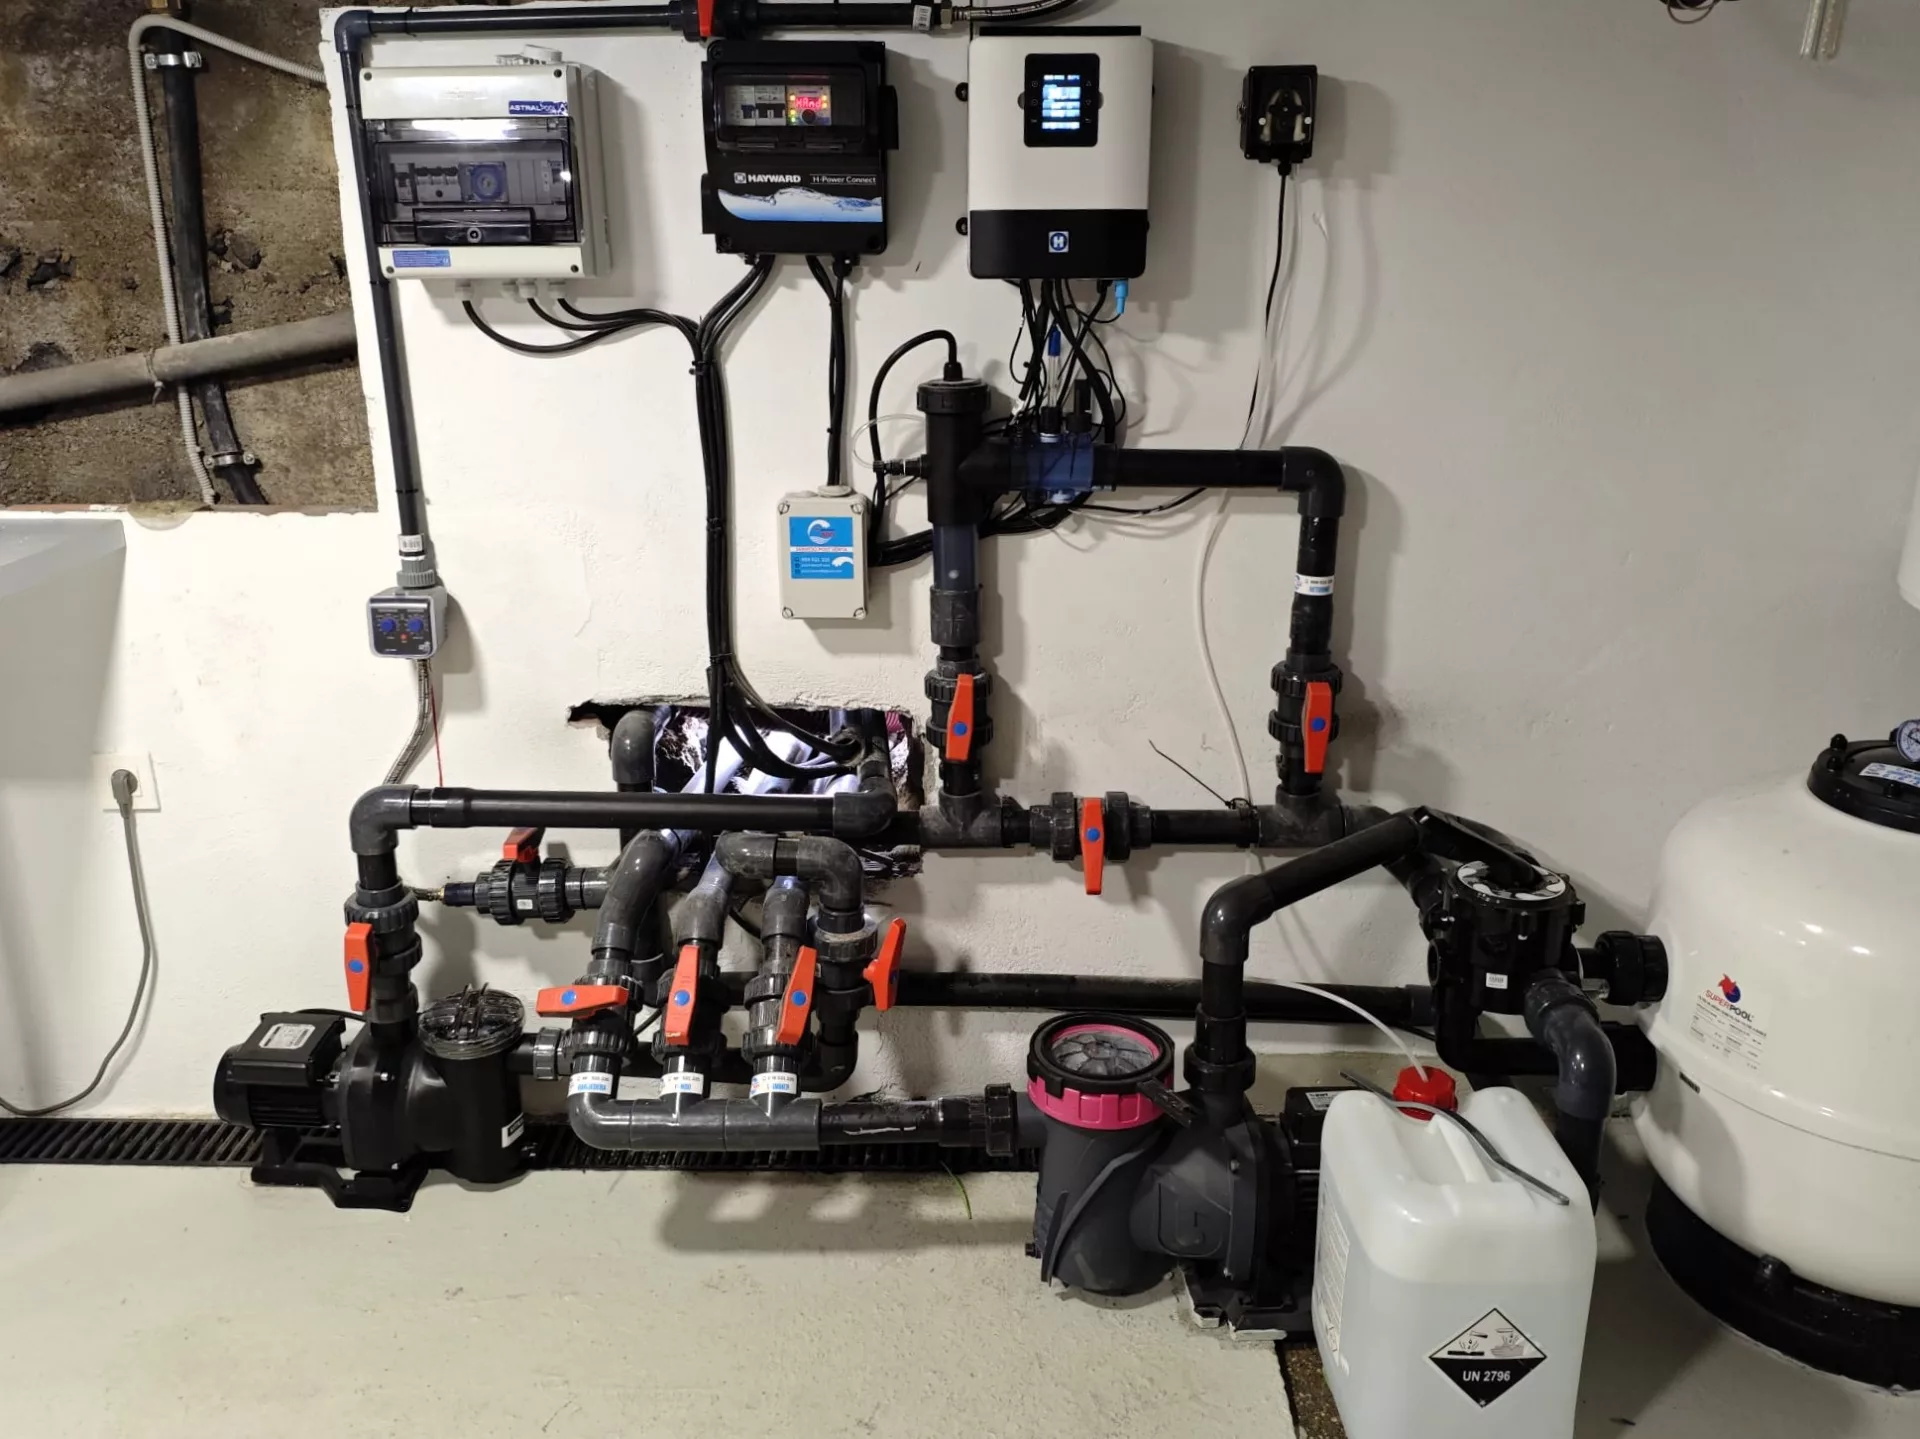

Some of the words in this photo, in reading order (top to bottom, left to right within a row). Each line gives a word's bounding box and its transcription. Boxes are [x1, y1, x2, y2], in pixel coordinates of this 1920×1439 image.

[748, 174, 802, 183] HAYWARD
[846, 175, 877, 183] Connect
[1705, 989, 1753, 1023] SUPERPOOL
[1462, 1370, 1481, 1382] UN
[1483, 1370, 1511, 1382] 2796
